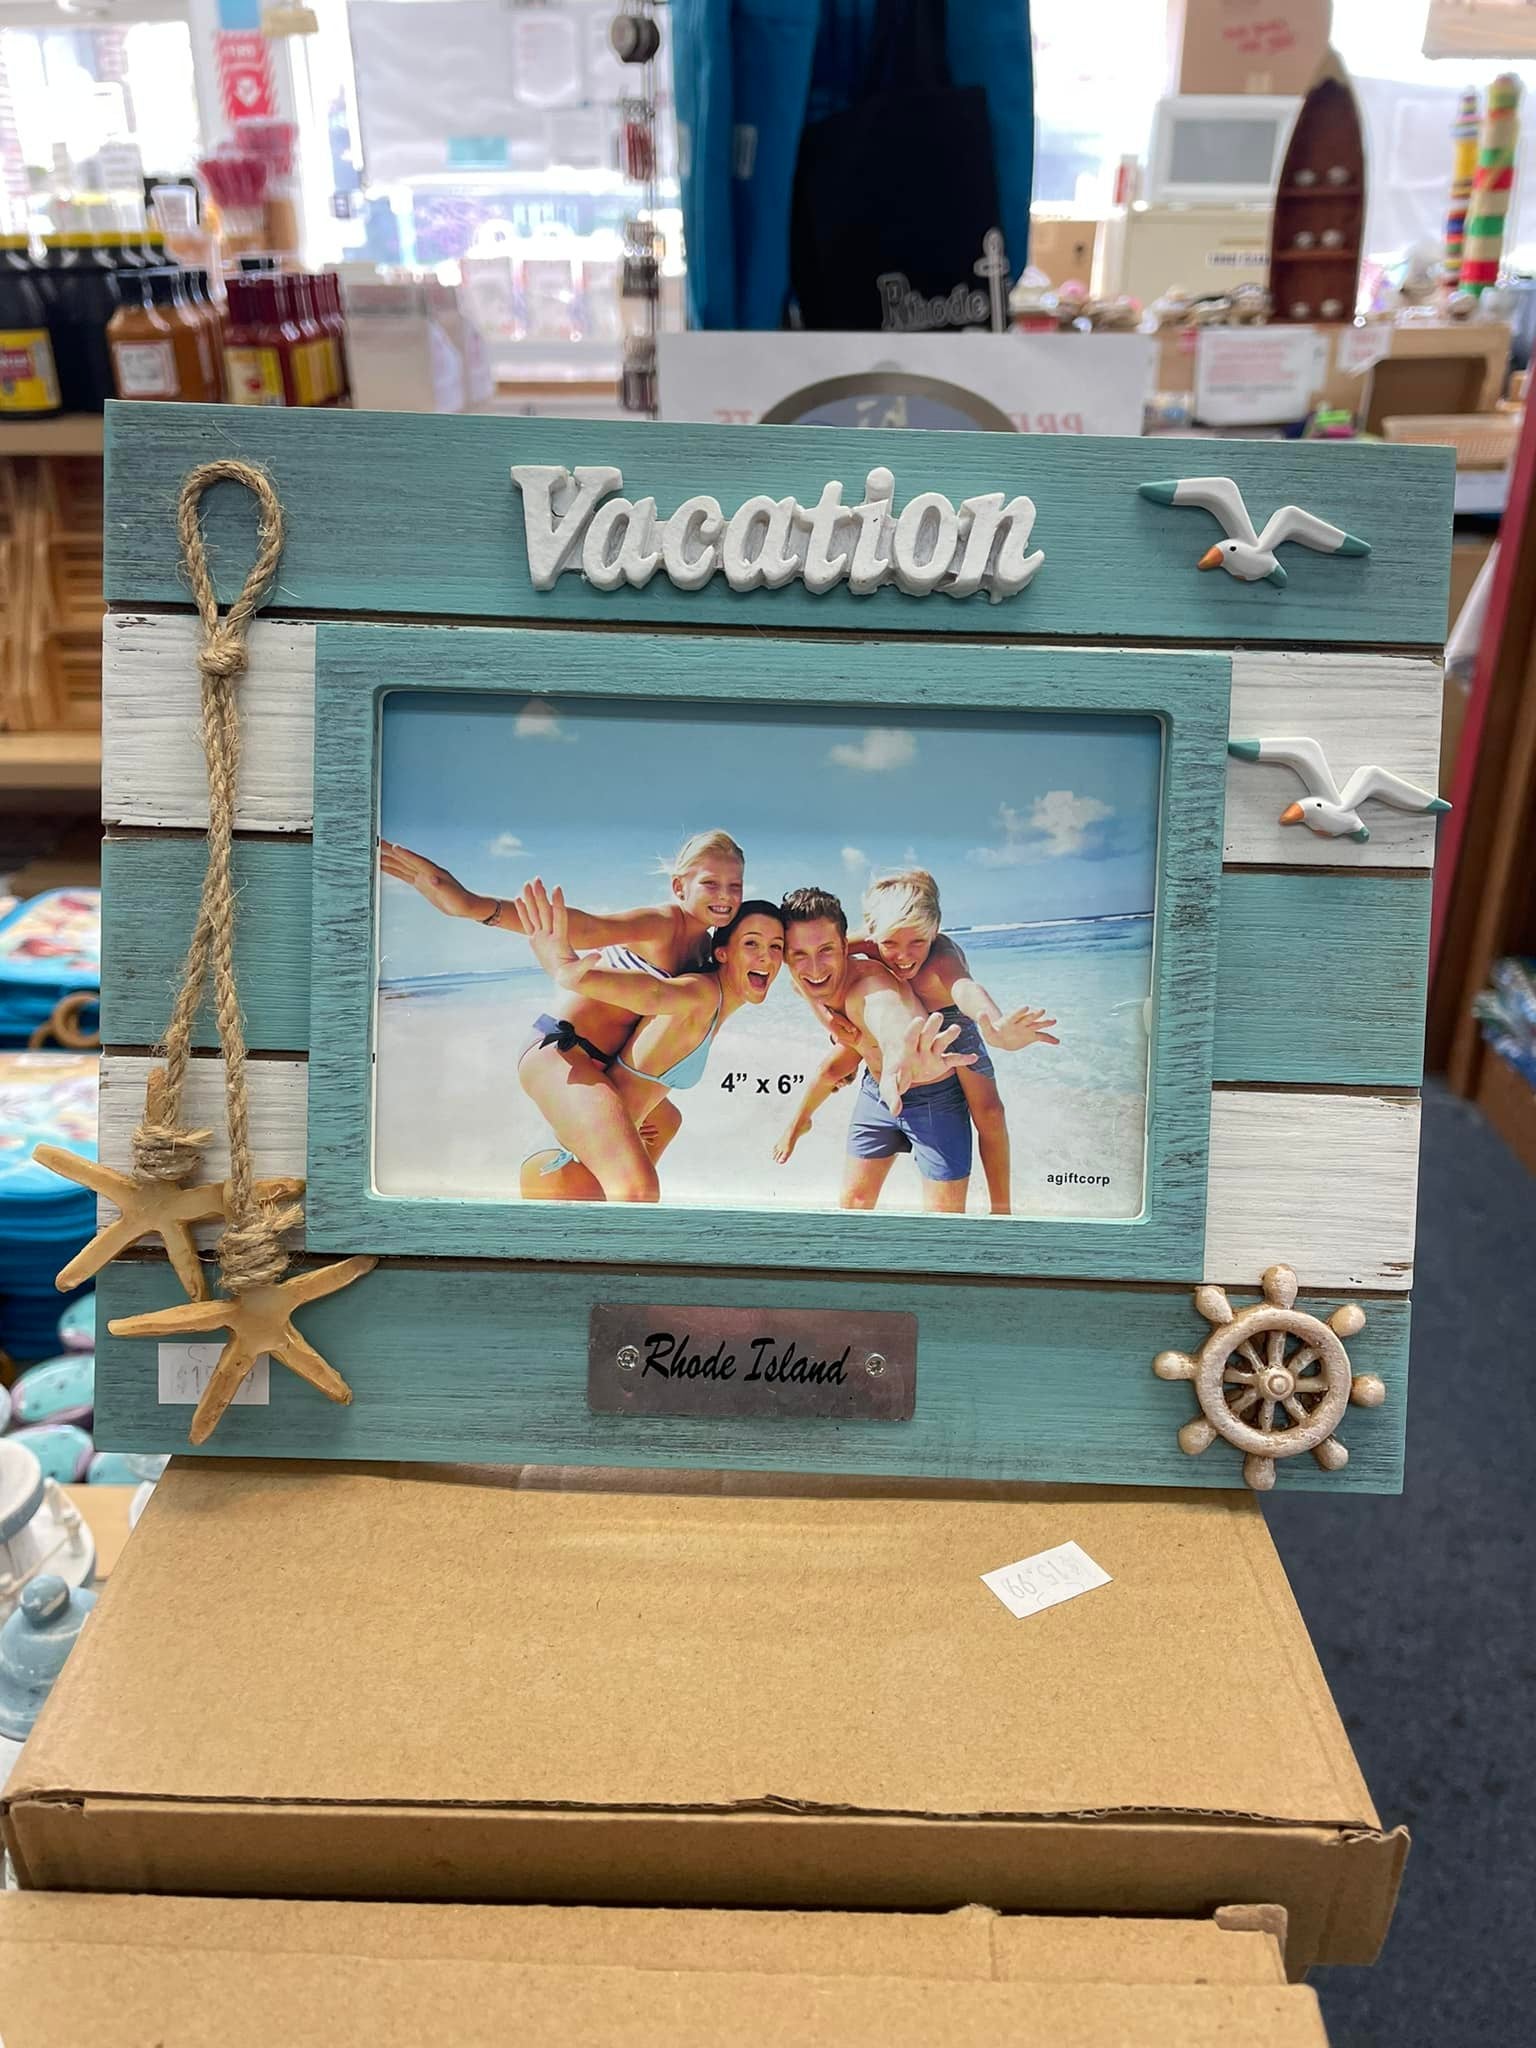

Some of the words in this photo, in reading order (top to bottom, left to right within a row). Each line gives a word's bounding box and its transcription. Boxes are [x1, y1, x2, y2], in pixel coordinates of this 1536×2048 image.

[511, 465, 1045, 604] Vacation
[756, 1078, 770, 1094] x
[1047, 1172, 1111, 1187] agiftcorp
[641, 1332, 737, 1380] Rhode
[743, 1337, 852, 1386] Island
